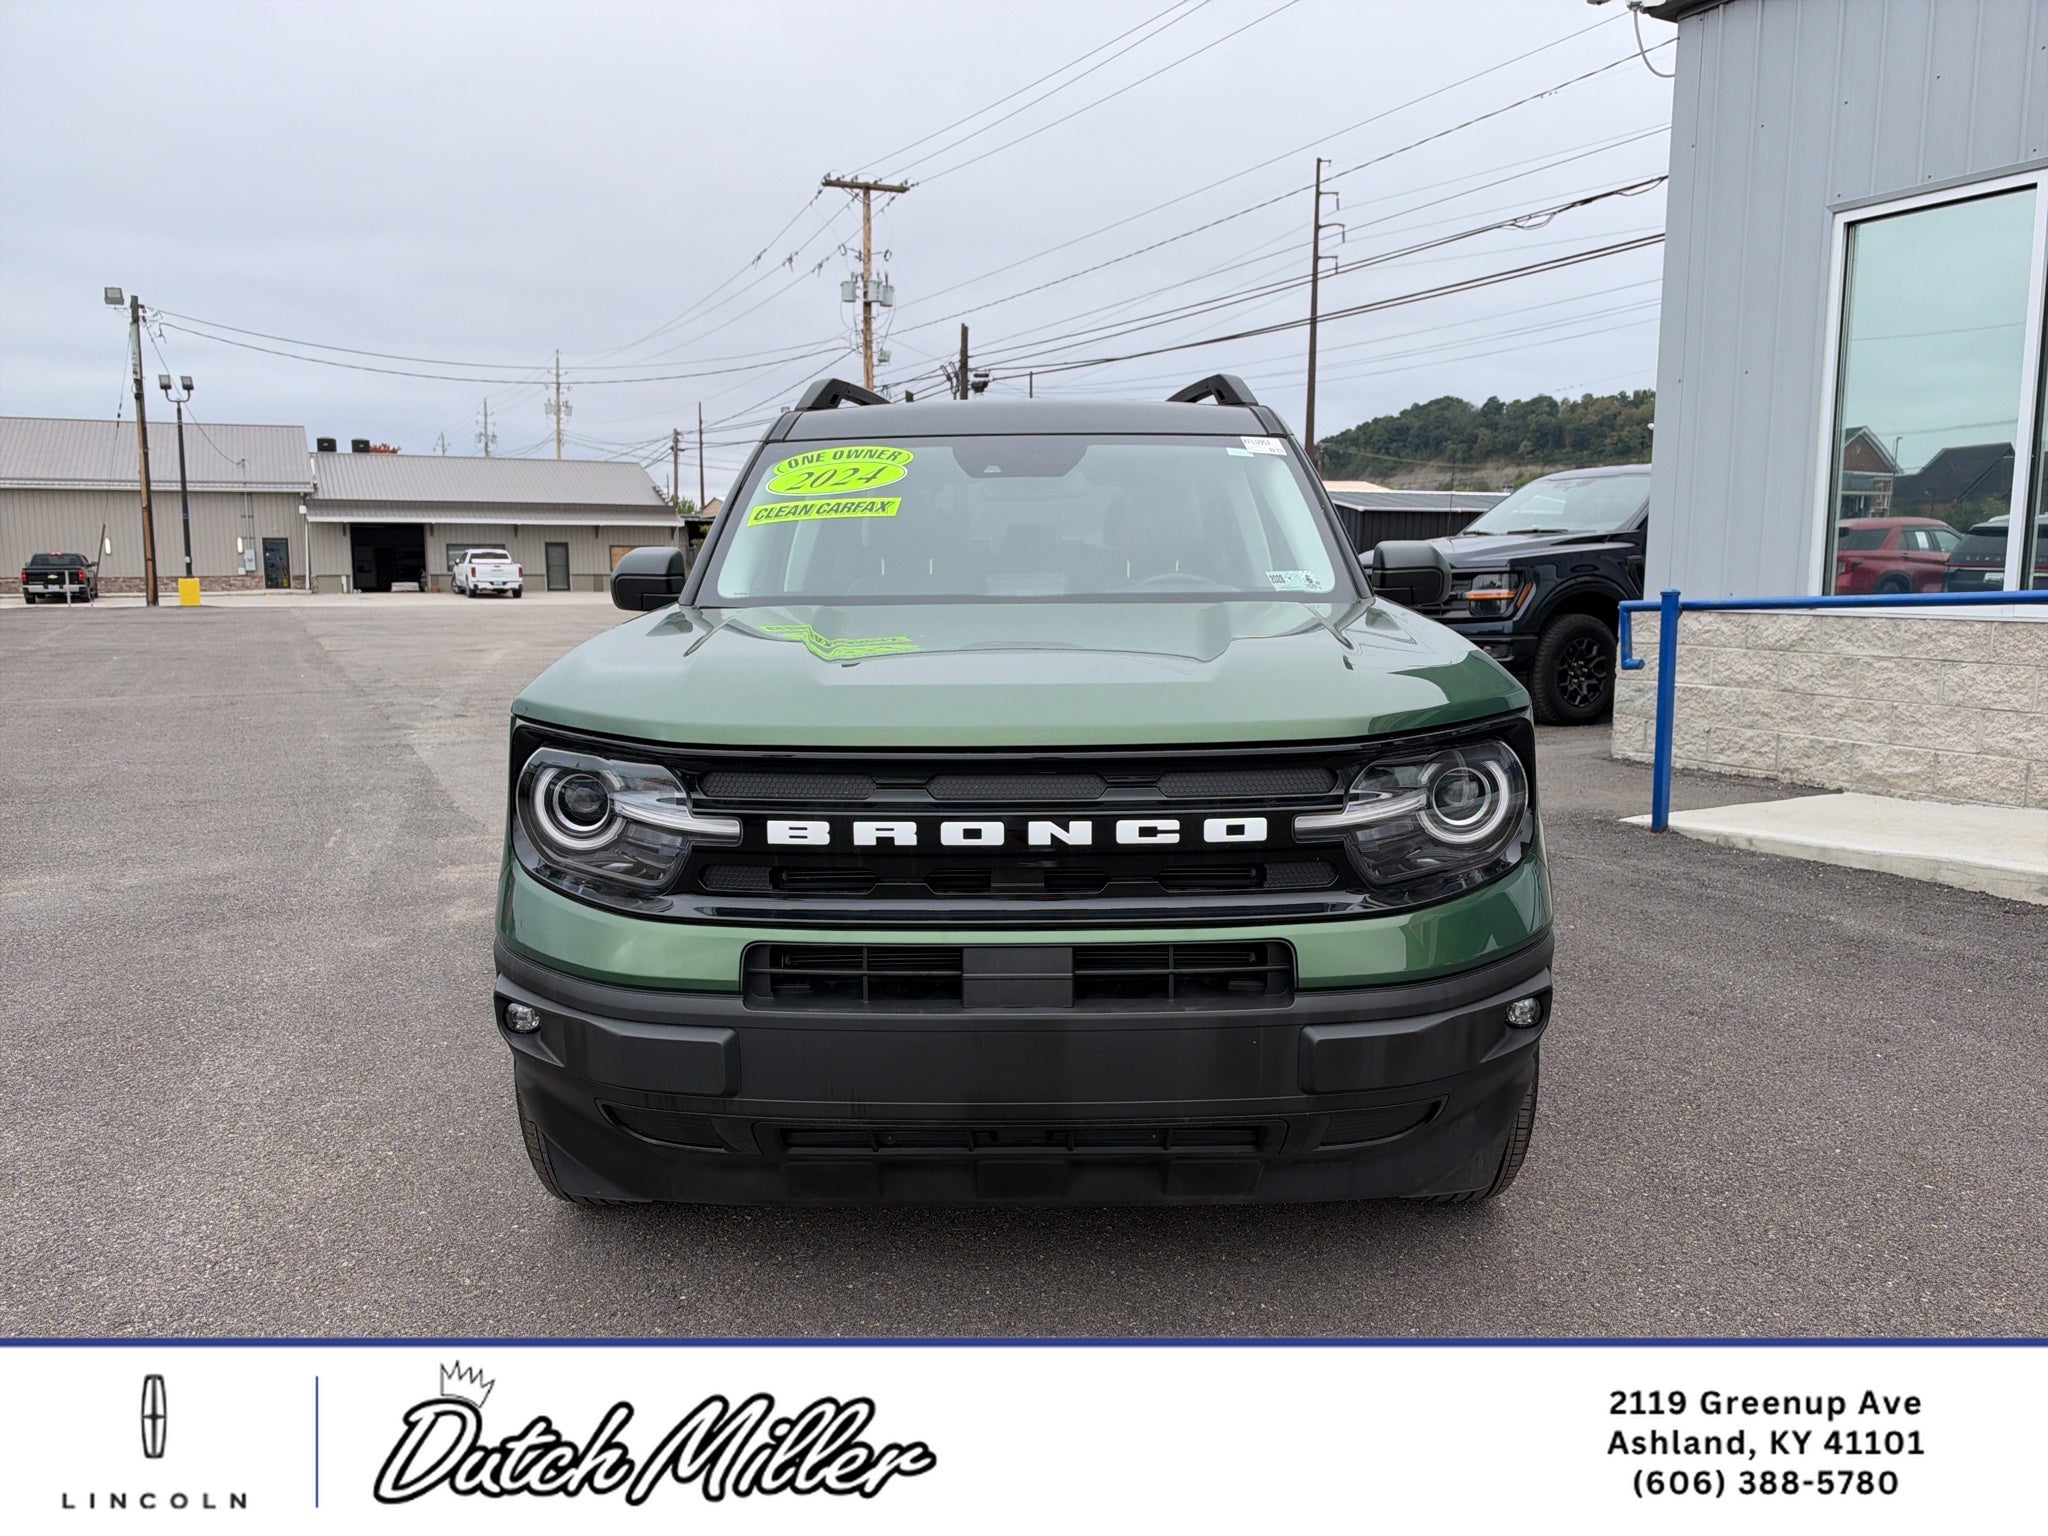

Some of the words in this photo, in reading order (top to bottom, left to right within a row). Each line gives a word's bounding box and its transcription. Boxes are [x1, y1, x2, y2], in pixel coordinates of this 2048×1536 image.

[787, 452, 826, 469] ONE
[832, 449, 903, 462] OWNER
[784, 465, 889, 491] 2024
[753, 503, 816, 521] CLEAN
[815, 500, 896, 517] CARFAX
[767, 817, 1268, 846] BRONCO
